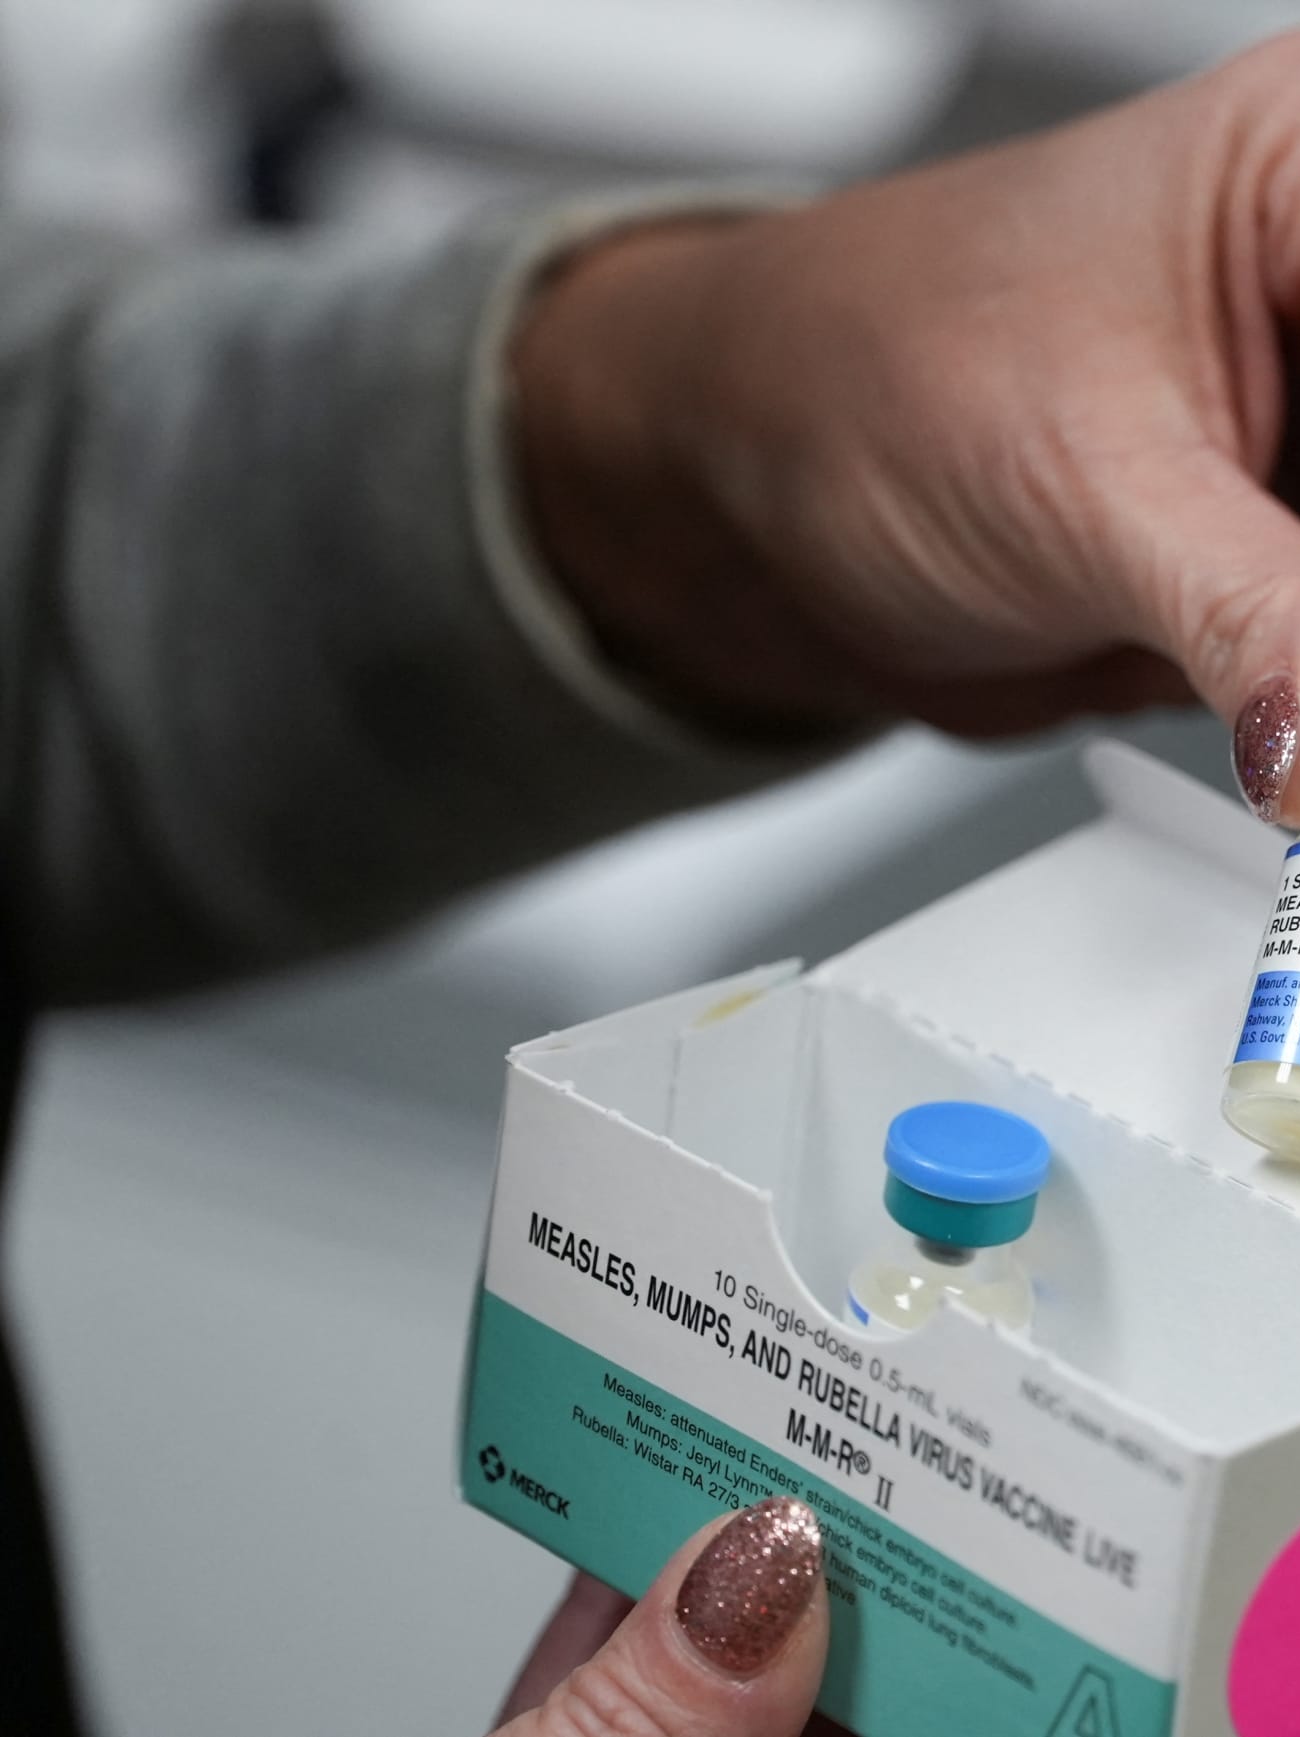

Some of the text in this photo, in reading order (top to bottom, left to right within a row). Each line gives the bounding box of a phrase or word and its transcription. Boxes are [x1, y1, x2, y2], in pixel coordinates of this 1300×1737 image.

[1283, 876, 1290, 892] 1
[1246, 1014, 1286, 1027] Rahway,
[1252, 995, 1281, 1009] Merck
[1257, 976, 1288, 990] Manuf.
[1241, 1031, 1257, 1046] U.S.
[713, 1270, 992, 1448] 10 Single-dose 0.5-mL vials
[528, 1211, 640, 1307] MEASLES,
[646, 1275, 735, 1359] MUMPS,
[741, 1329, 792, 1381] AND
[798, 1357, 901, 1448] RUBELLA
[909, 1422, 974, 1491] VIRUS
[980, 1465, 1076, 1555] VACCINE
[1084, 1526, 1138, 1591] LIVE
[510, 1469, 570, 1520] MERCK
[603, 1372, 667, 1420] Measles:
[670, 1412, 747, 1464] attenuated
[806, 1488, 882, 1545] strain/chick
[886, 1539, 937, 1579] embryo
[940, 1572, 965, 1595] cell
[786, 1407, 894, 1512] M-M-R® II
[572, 1405, 630, 1451] Rubella:
[634, 1438, 680, 1475] Wistar
[682, 1466, 704, 1492] RA
[708, 1481, 740, 1511] 27/3
[830, 1552, 876, 1594] human
[880, 1586, 925, 1625] diploid
[928, 1613, 958, 1648] lung
[626, 1410, 683, 1454] Mumps:
[686, 1446, 721, 1475] Jeryl
[856, 1547, 908, 1588] embryo
[911, 1580, 936, 1603] cell
